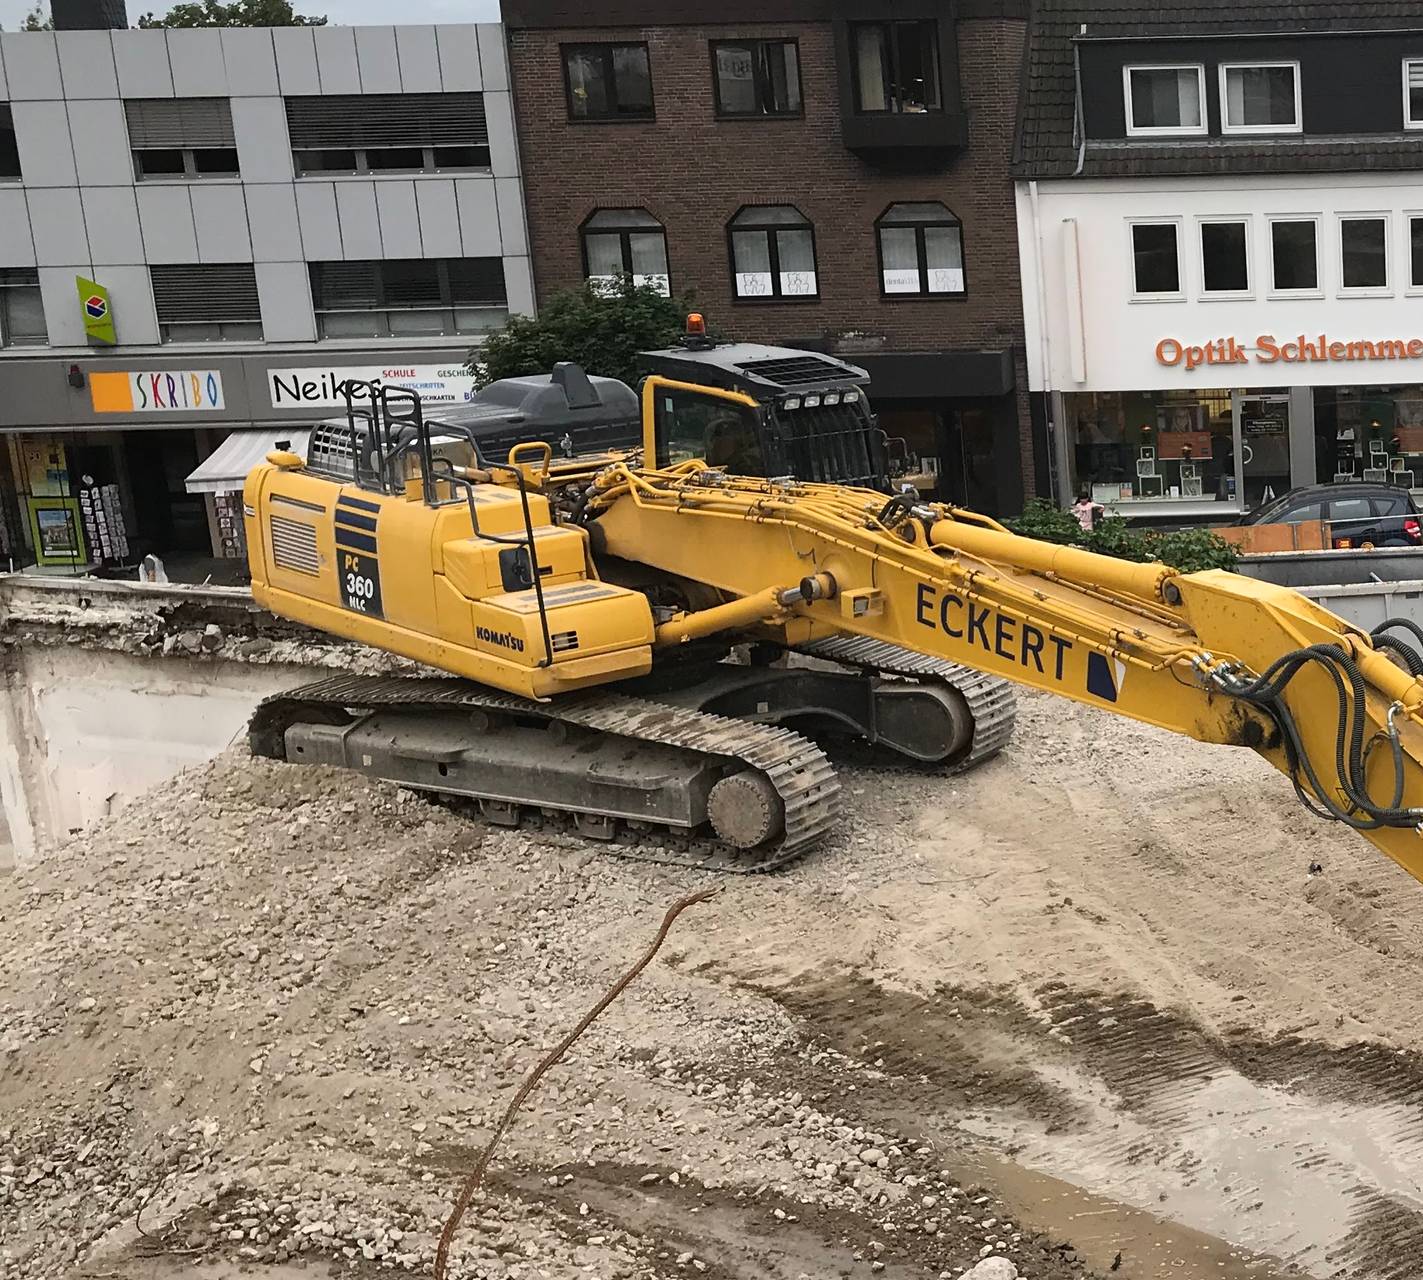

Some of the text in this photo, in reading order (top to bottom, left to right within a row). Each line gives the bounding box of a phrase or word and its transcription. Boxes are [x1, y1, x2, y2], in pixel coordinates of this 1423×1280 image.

[1155, 336, 1248, 371] Optik
[273, 372, 381, 402] Neikes
[382, 369, 473, 378] SCHULE GESCHEN
[136, 373, 217, 408] SKRIBO
[344, 554, 359, 573] PC
[346, 572, 374, 599] 360
[349, 596, 366, 612] NLC
[476, 625, 525, 653] KOMATSU
[916, 582, 1073, 681] ECKERT
